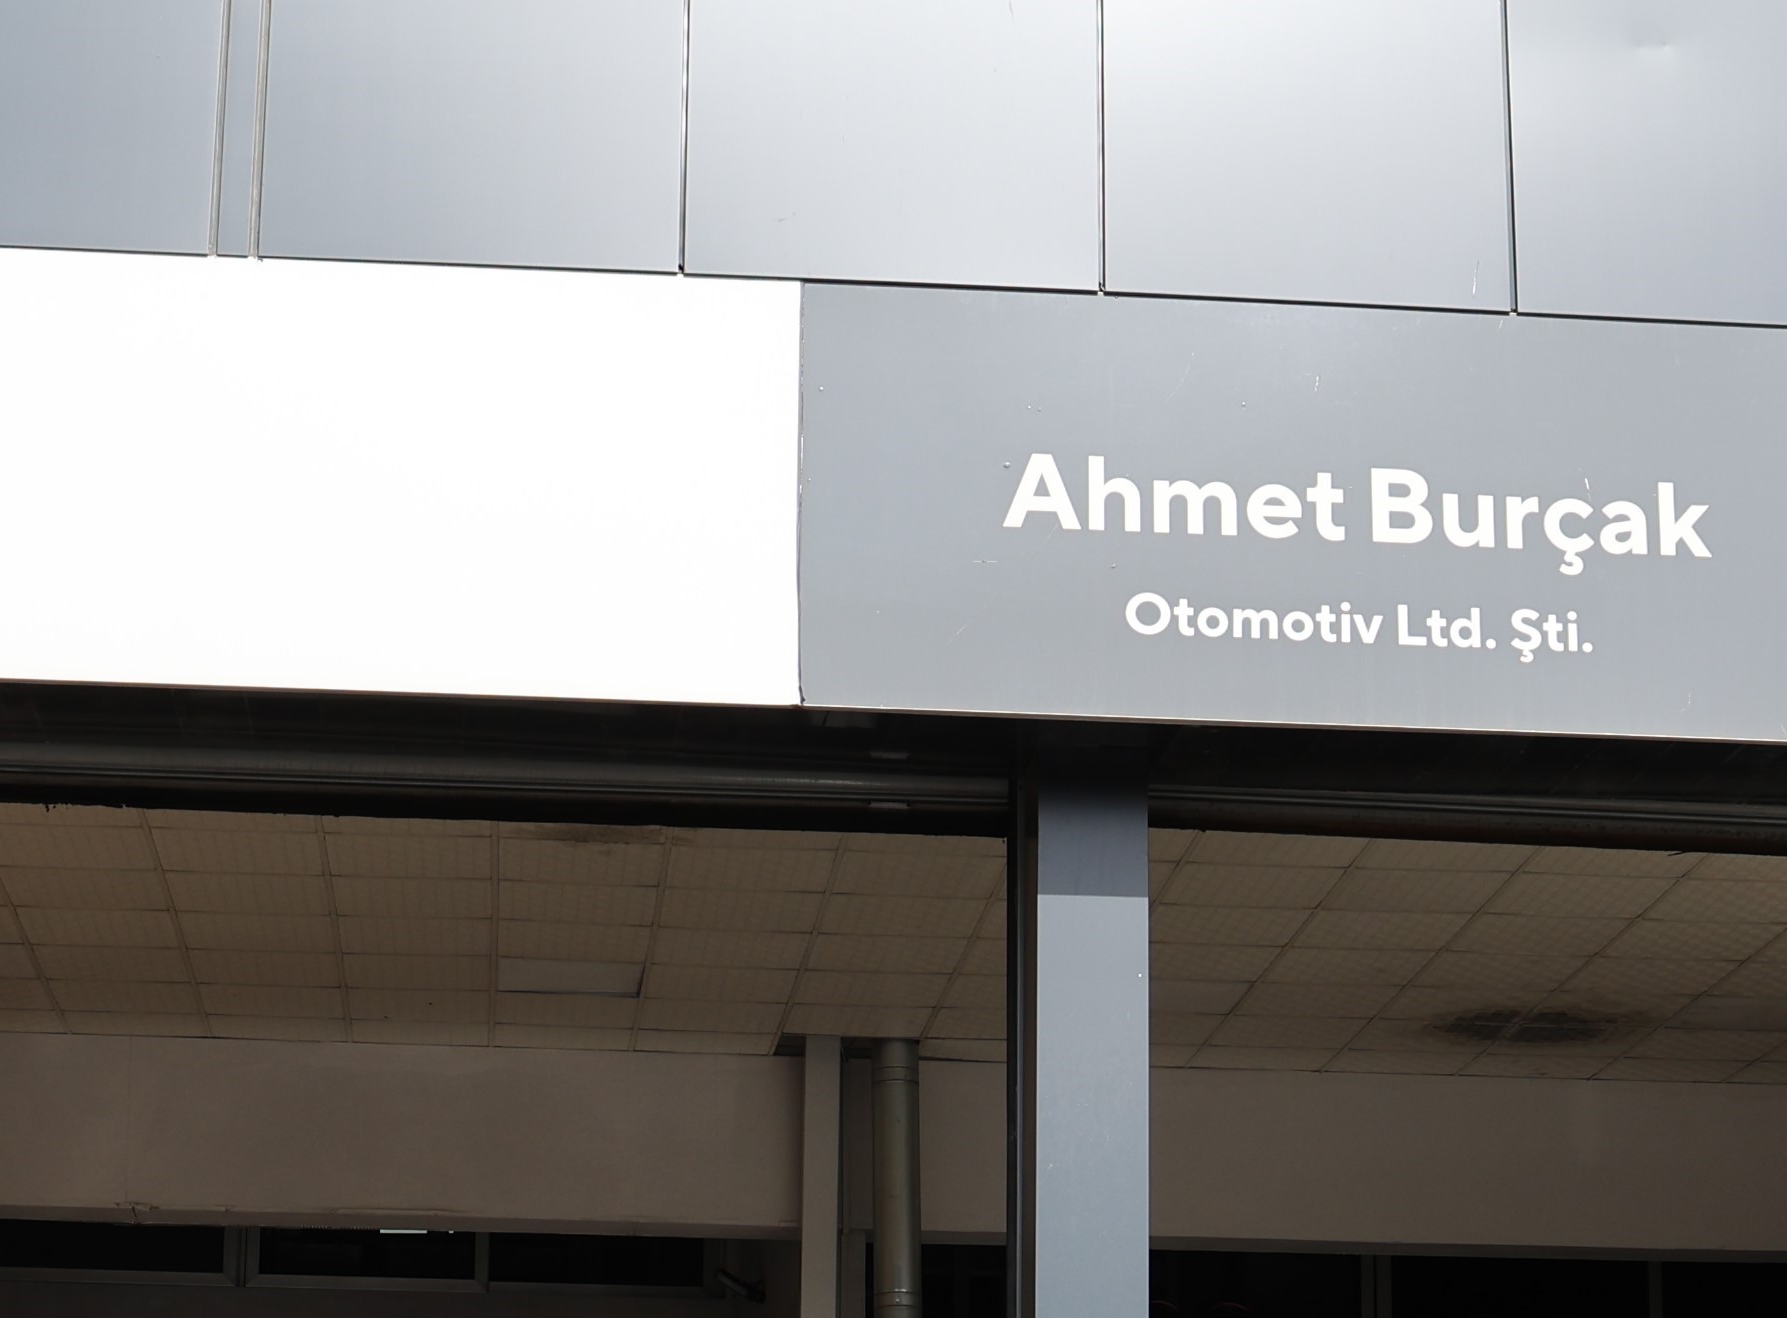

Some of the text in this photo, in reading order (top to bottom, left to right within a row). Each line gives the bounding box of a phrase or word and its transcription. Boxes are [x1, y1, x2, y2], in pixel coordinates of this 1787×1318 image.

[1002, 453, 1713, 576] Ahmet Burçak
[1124, 591, 1594, 664] Otomotiv Ltd. Şti.
